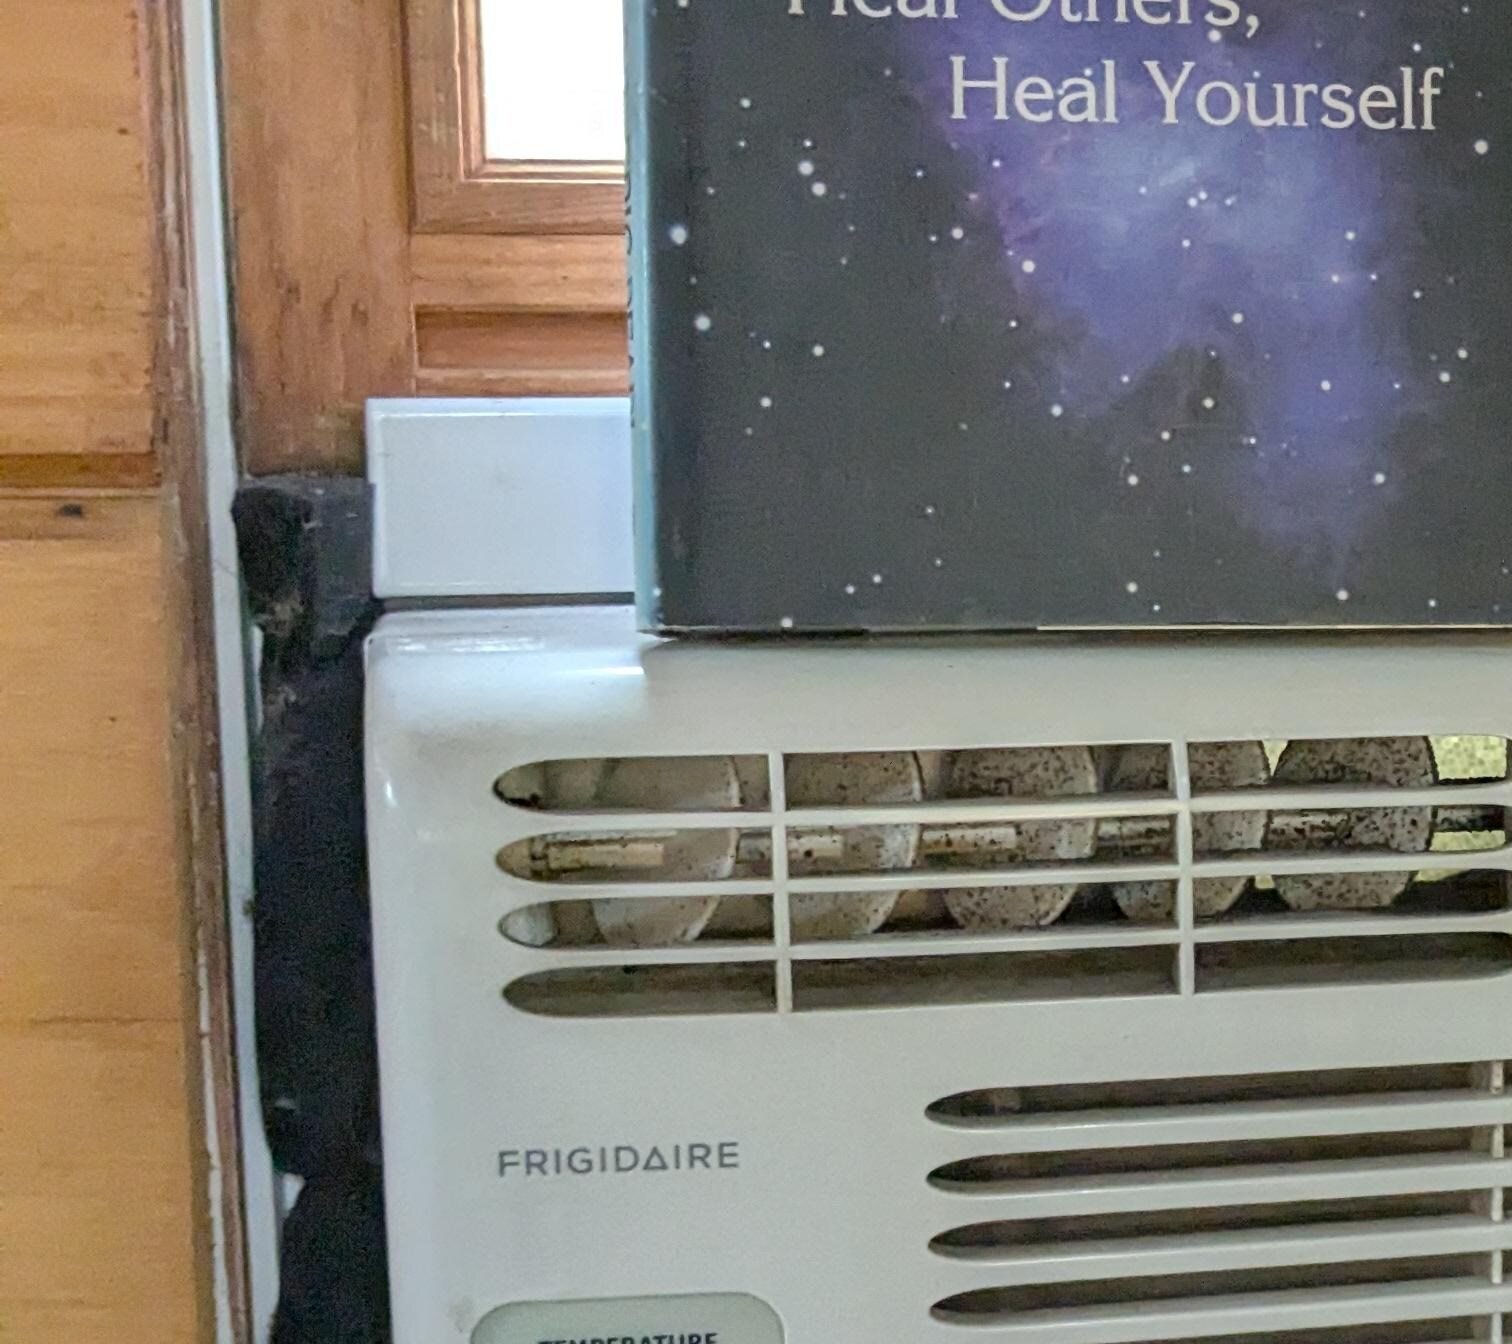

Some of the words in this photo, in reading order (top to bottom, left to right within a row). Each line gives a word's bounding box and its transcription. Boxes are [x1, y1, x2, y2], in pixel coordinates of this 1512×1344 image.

[951, 56, 1118, 124] Heal
[1143, 59, 1444, 130] Yourself
[497, 1141, 739, 1177] FRIGIDAIRE
